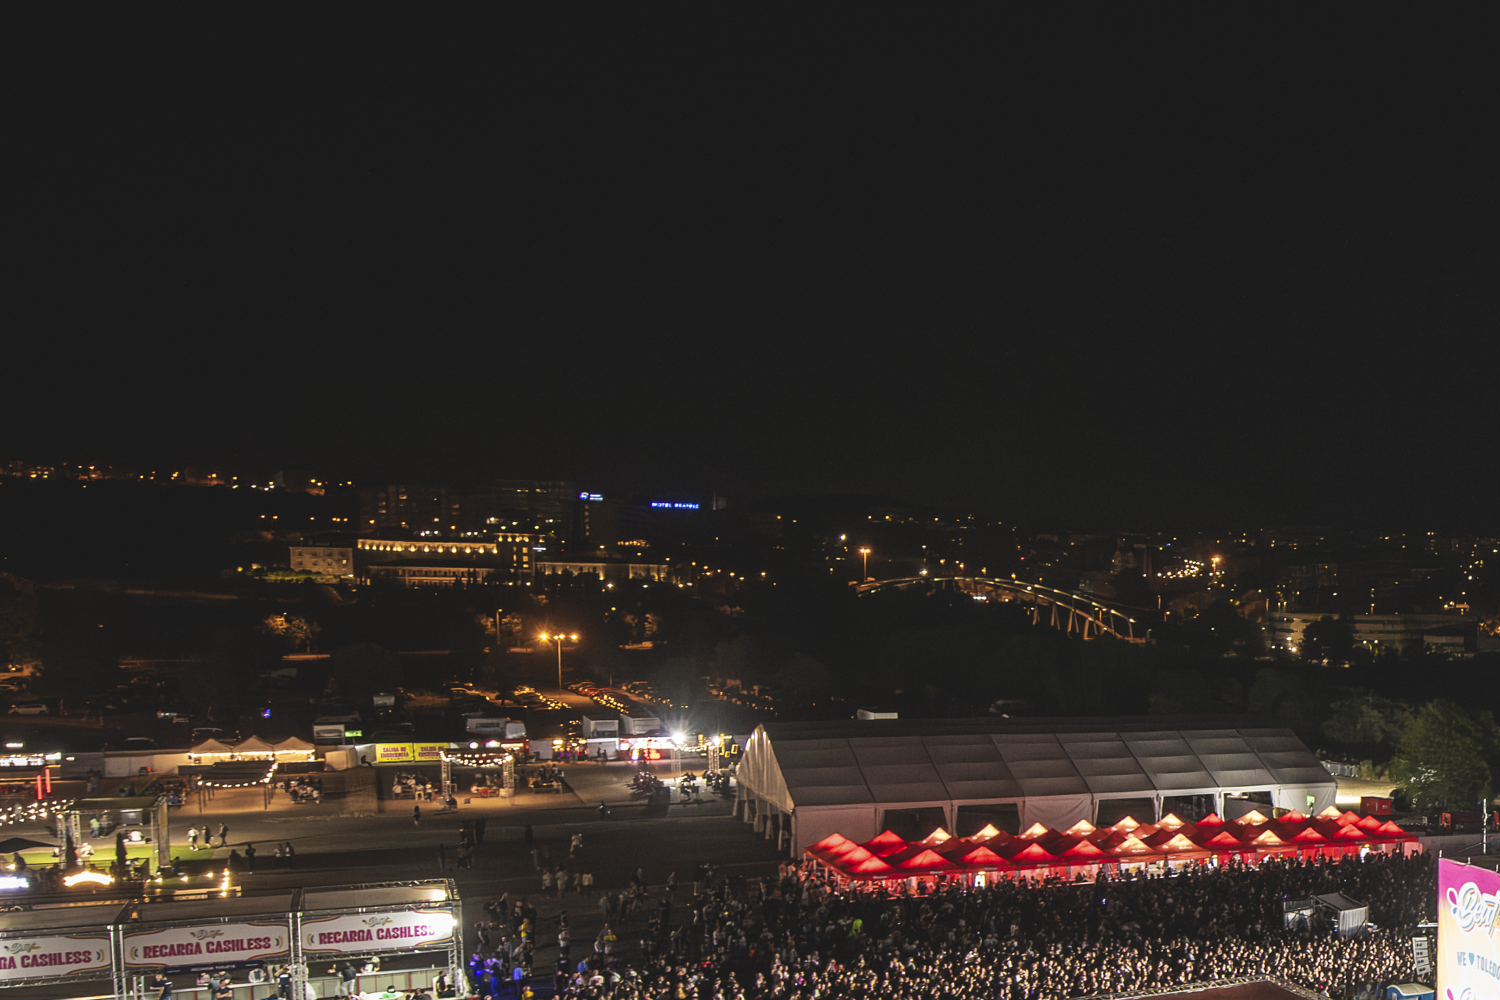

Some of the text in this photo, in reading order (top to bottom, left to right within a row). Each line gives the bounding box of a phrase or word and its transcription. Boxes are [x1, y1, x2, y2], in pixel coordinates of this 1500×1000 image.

[318, 929, 373, 945] RECARGA
[143, 937, 271, 958] RECARGA CASHLESS
[21, 951, 92, 969] CASHLESS
